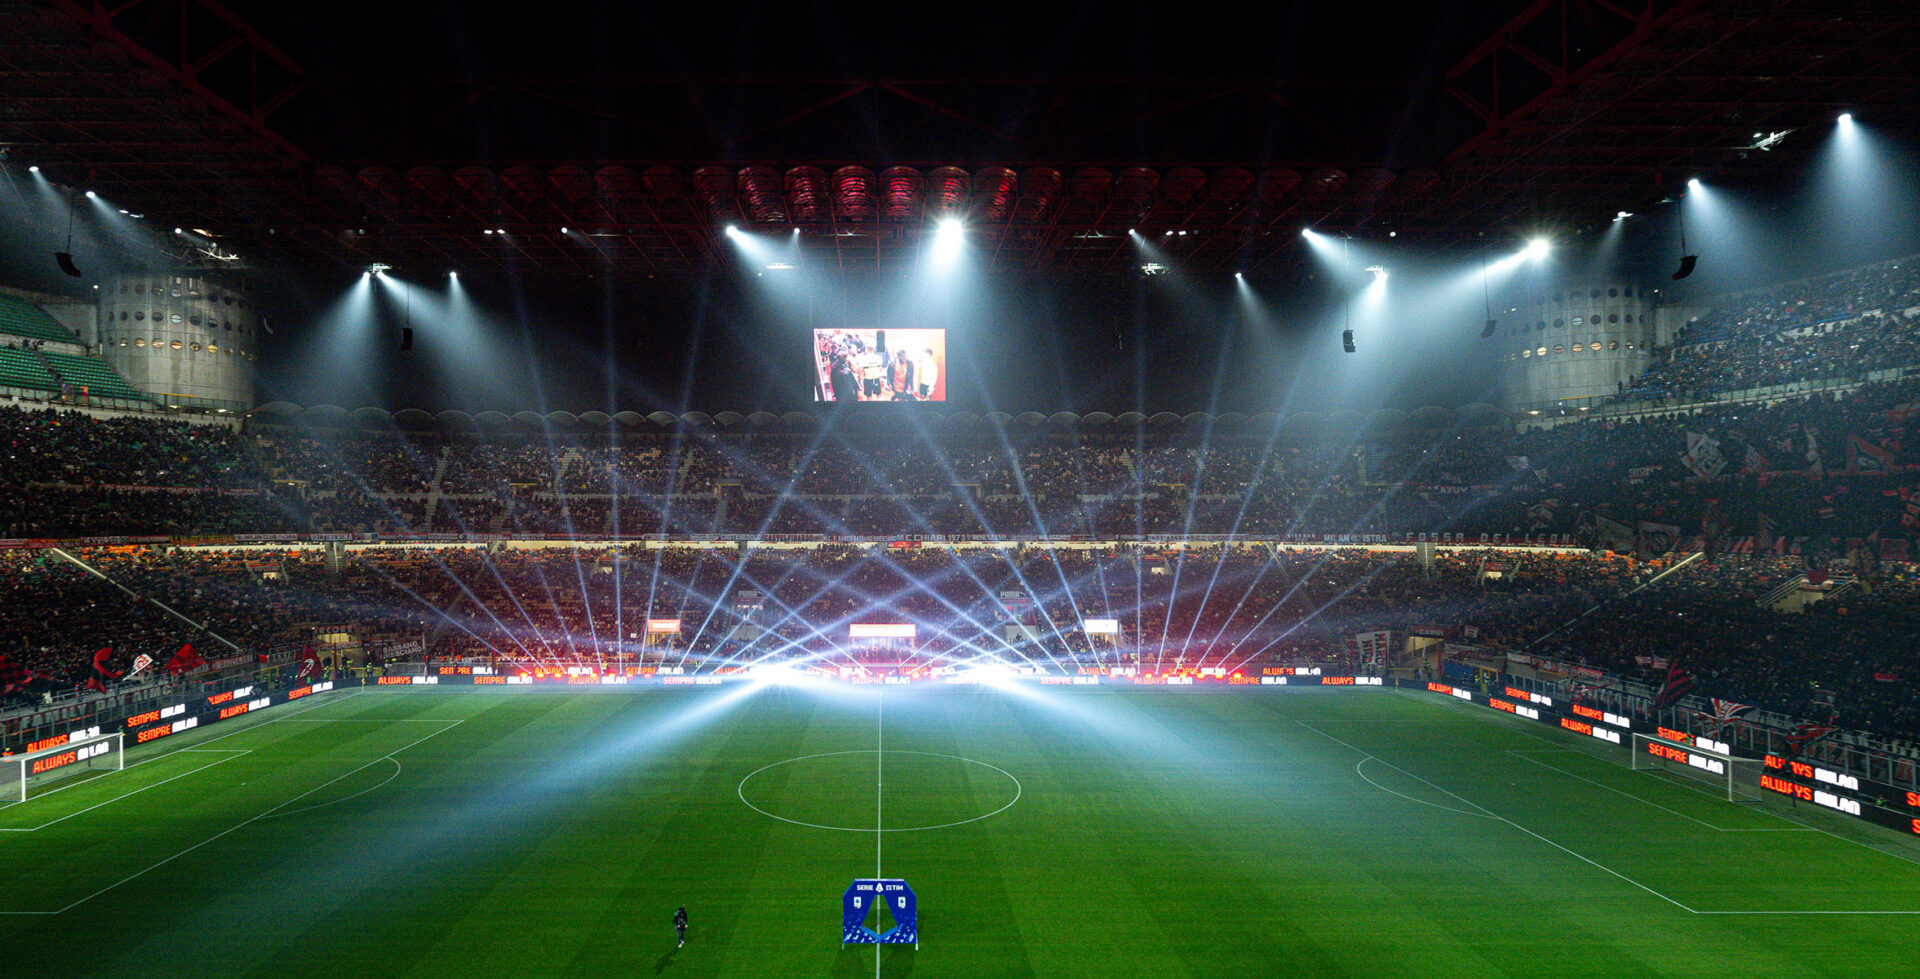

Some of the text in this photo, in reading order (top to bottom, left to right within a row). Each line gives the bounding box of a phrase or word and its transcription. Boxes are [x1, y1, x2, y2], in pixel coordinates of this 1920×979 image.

[1406, 532, 1464, 542] FOSSA
[1480, 533, 1510, 542] DEI
[534, 667, 566, 675] ALWAYS
[626, 667, 658, 675] SEMPRE
[1078, 667, 1108, 675] ALWAYS
[378, 676, 411, 684] ALWAYS
[474, 676, 506, 684] SEMPRE
[568, 676, 600, 684] ALWAYS
[663, 676, 695, 684] SEMPRE
[1040, 676, 1072, 684] SEMPRE
[1134, 676, 1166, 684] ALWAYS
[1228, 676, 1260, 684] SEMPRE
[1322, 676, 1354, 684] ALWAYS
[288, 686, 312, 700] SEMPRE
[1428, 682, 1452, 695] ALWAYS
[1505, 686, 1530, 701] SEMPRE
[220, 702, 248, 719] ALWAYS
[1490, 698, 1516, 714] SEMPRE
[1572, 704, 1603, 720] ALWAYS
[128, 710, 160, 728] SEMPRE
[138, 724, 172, 742] SEMPRE
[1560, 717, 1592, 736] ALWAYS
[26, 734, 68, 754] ALWAYS
[32, 751, 76, 774] ALWAYS
[1814, 768, 1858, 790] MILAN
[1814, 790, 1860, 816] MILAN
